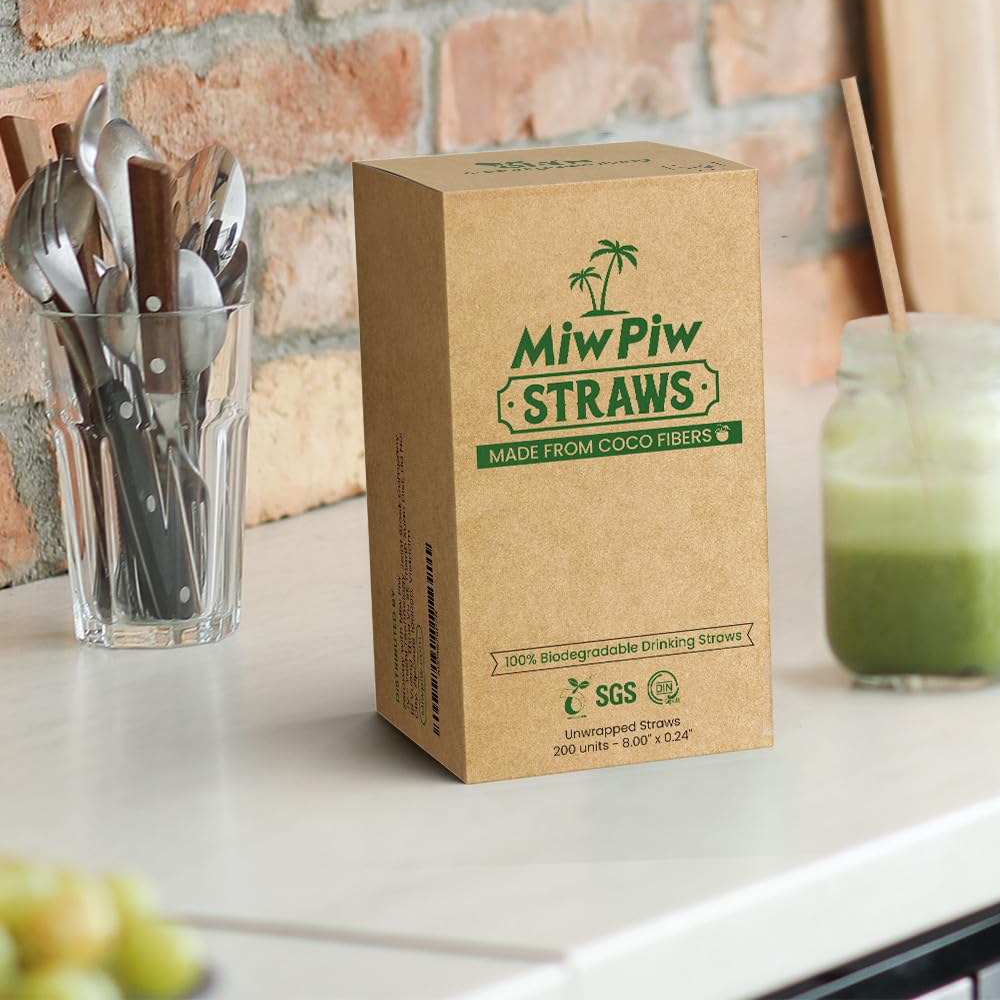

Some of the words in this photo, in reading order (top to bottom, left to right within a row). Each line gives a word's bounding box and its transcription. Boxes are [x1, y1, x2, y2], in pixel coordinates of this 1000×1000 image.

[511, 321, 614, 369] Miw
[617, 313, 703, 360] Piw
[523, 371, 694, 425] STRAWS
[489, 446, 538, 464] MADE
[544, 440, 593, 458] FROM
[598, 434, 652, 453] COCO
[657, 428, 713, 447] FIBERS
[504, 653, 537, 668] 100%
[541, 642, 638, 662] Biodegradable
[642, 635, 695, 651] Drinking
[698, 631, 742, 645] Straws
[595, 681, 637, 708] SGS
[655, 682, 673, 694] DIN
[553, 744, 576, 757] 200
[579, 740, 610, 754] units
[622, 733, 652, 748] 8.00"
[655, 736, 662, 744] x
[664, 729, 693, 743] 0.24"
[565, 720, 636, 740] Unwrapped
[640, 717, 681, 731] Straws
